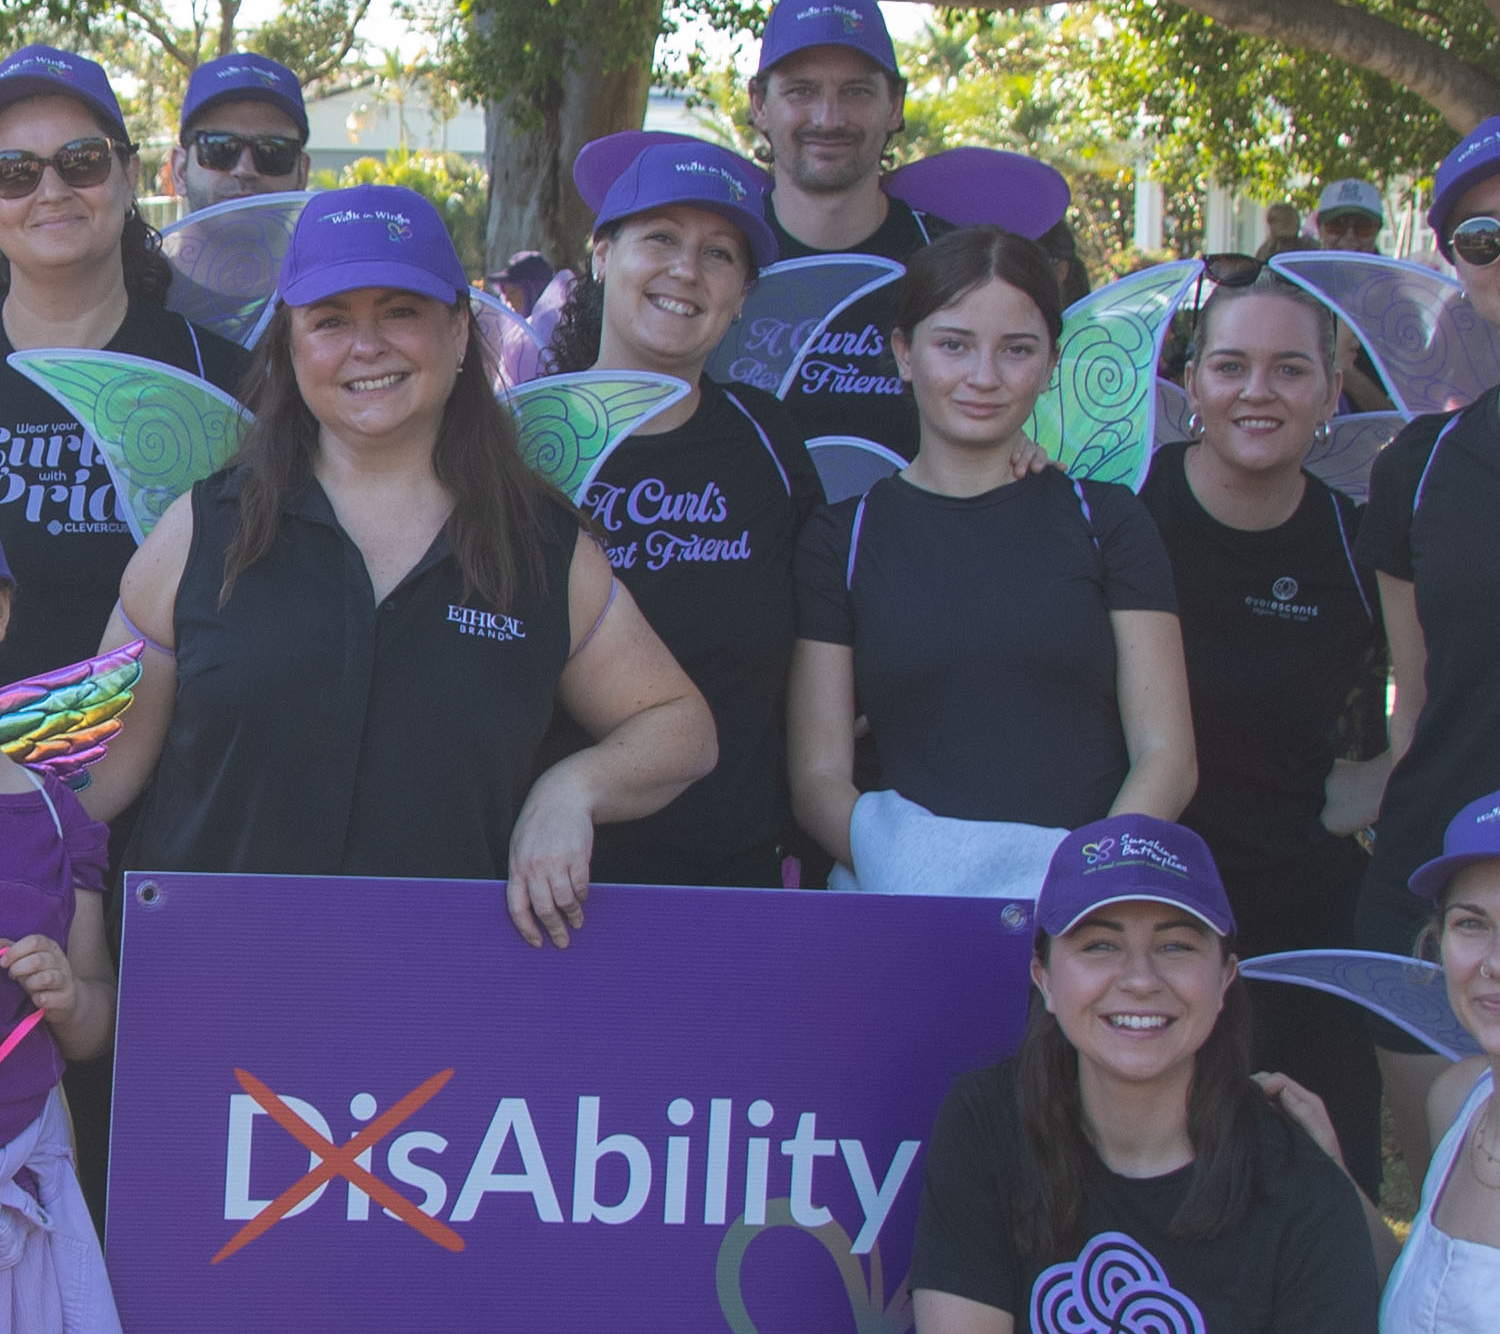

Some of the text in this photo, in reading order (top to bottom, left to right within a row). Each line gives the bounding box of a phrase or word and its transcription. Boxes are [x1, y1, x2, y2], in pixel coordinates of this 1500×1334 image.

[16, 421, 79, 435] Wear your
[38, 469, 67, 482] with
[584, 477, 728, 532] A Curl's
[645, 530, 752, 571] Friend
[446, 604, 527, 639] ETHICAL
[223, 1093, 922, 1254] DisAbility
